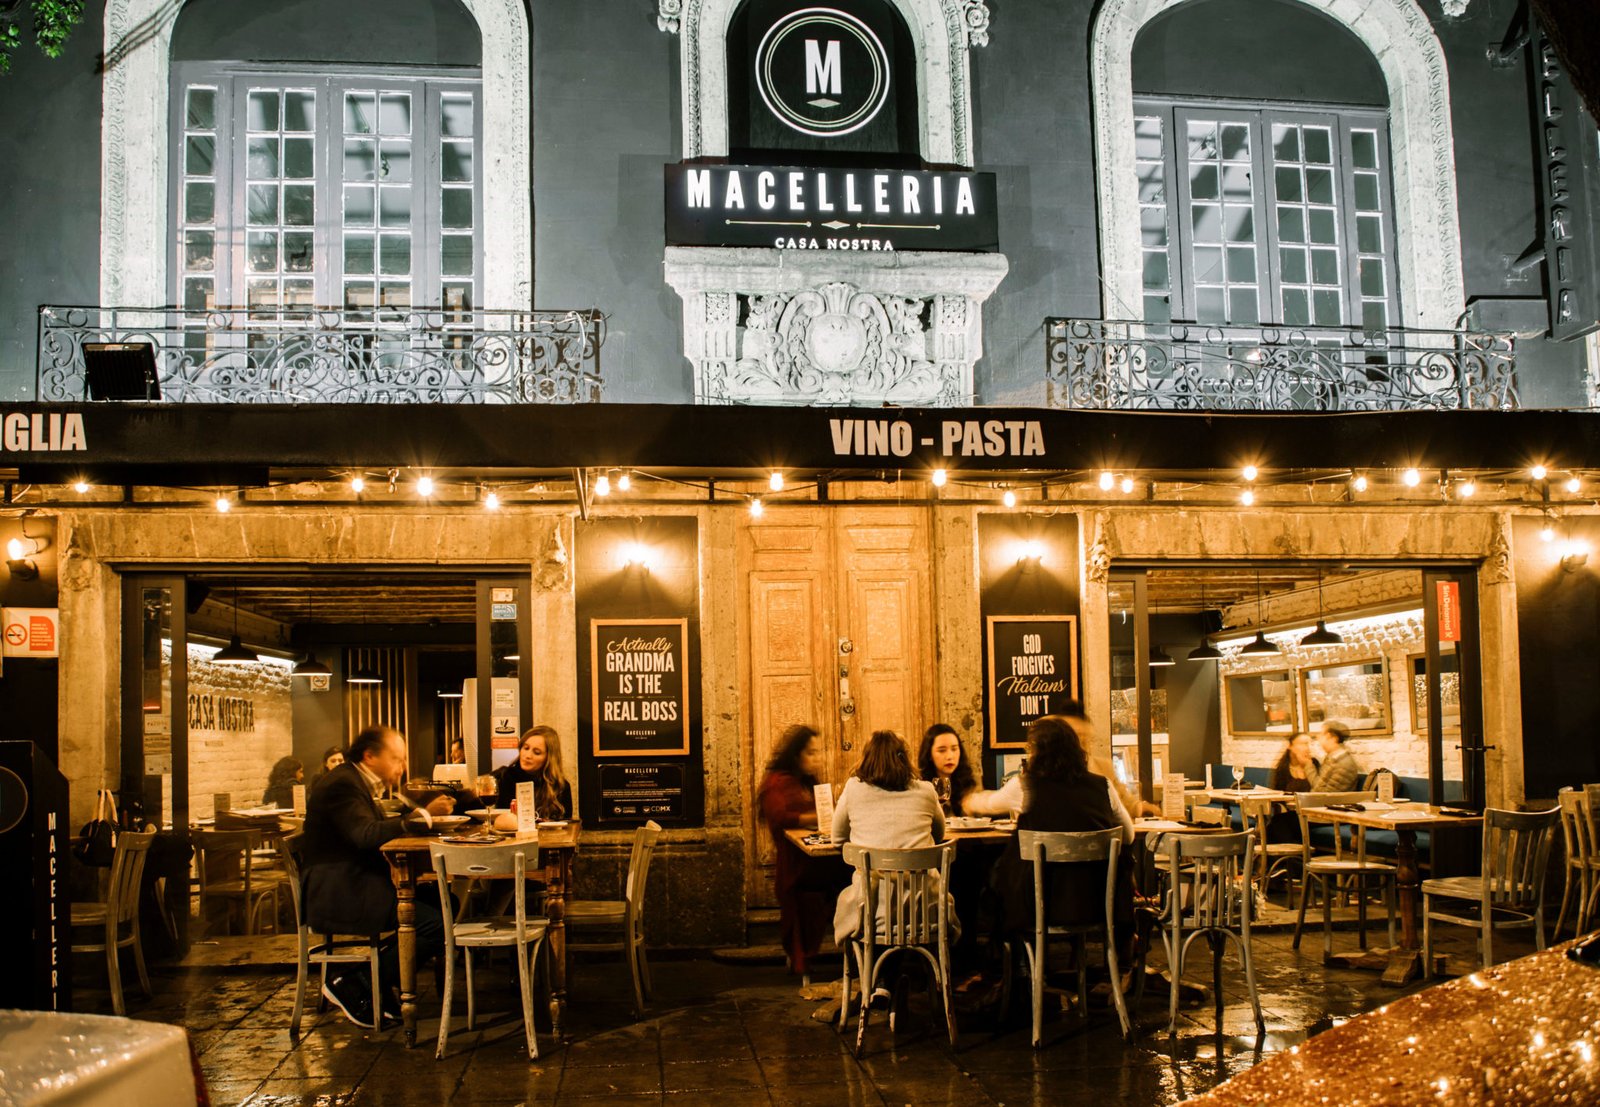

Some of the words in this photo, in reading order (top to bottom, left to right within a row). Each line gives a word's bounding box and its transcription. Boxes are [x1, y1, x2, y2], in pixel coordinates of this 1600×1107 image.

[805, 39, 842, 95] M
[686, 169, 976, 216] MACELLERIA
[775, 237, 819, 251] CASA
[827, 238, 894, 252] NOSTRA
[0, 413, 88, 452] GLIA
[829, 419, 913, 457] VINO
[942, 420, 1046, 457] PASTA
[607, 637, 673, 656] Actually
[1023, 634, 1042, 654] GOD
[606, 652, 675, 673] GRANDMA
[1011, 655, 1055, 676] FORGIVES
[619, 674, 633, 694] IS
[636, 674, 662, 694] THE
[997, 675, 1067, 696] Italians
[189, 694, 216, 730] CASA
[218, 696, 255, 733] NOSTRA
[604, 701, 638, 721] REAL
[642, 701, 678, 721] BOSS
[1020, 695, 1050, 716] DON'T
[48, 812, 58, 1015] MACELLERI
